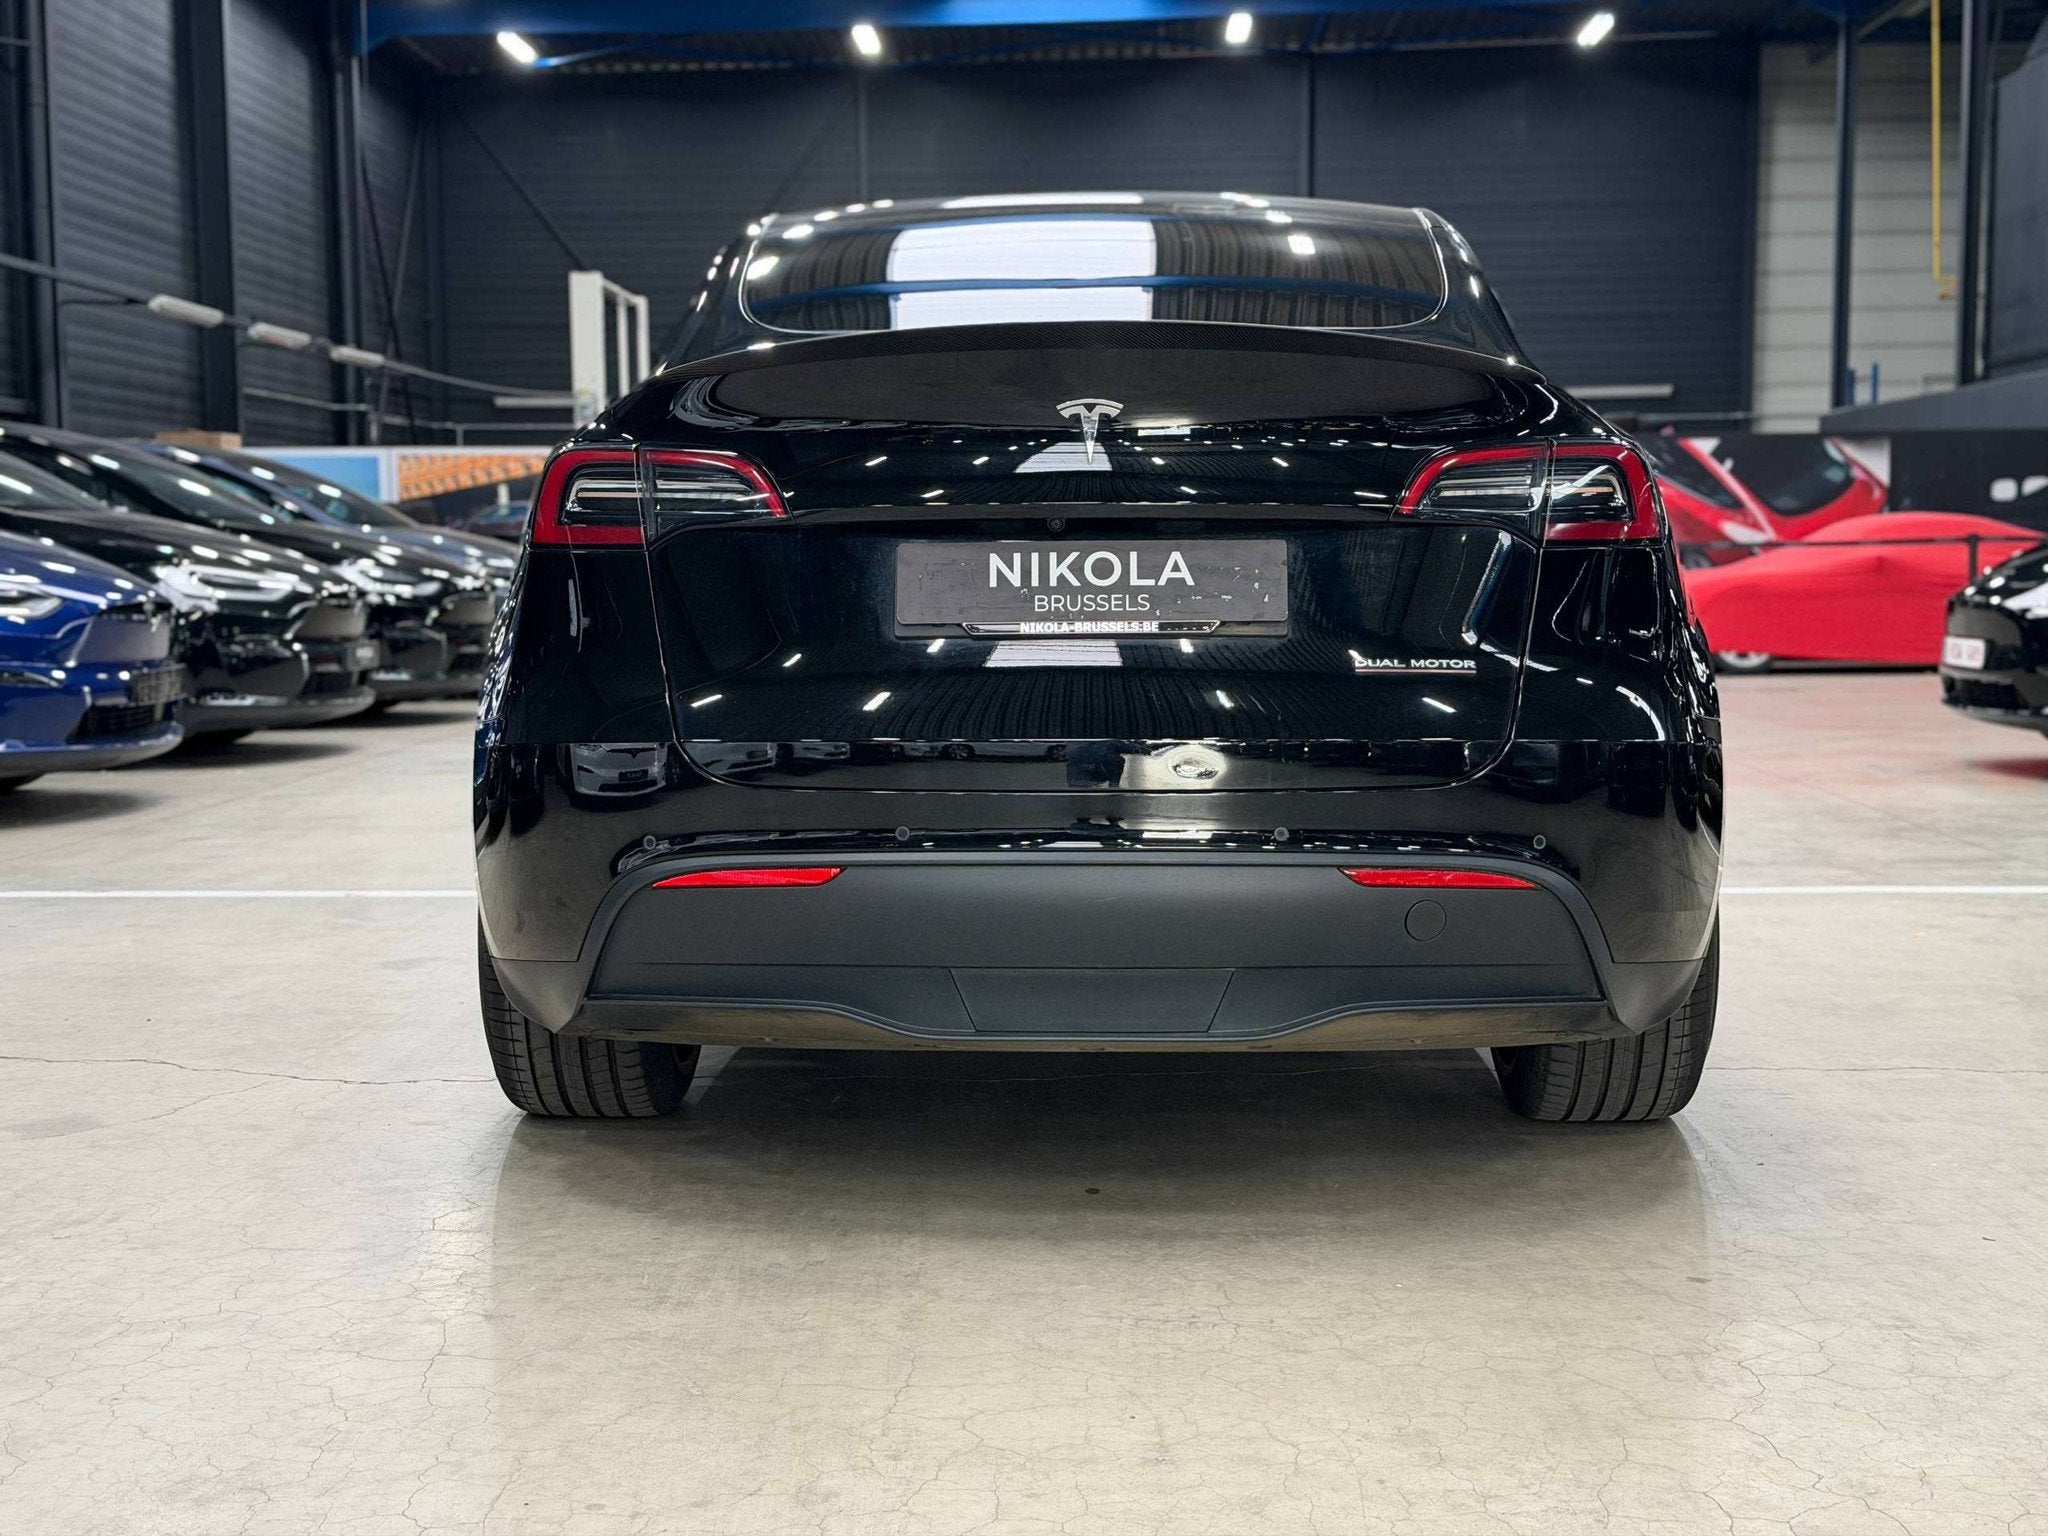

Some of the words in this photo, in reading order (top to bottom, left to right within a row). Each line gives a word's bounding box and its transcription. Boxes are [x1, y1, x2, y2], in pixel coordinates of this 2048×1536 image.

[988, 550, 1195, 588] NIKOLA
[1033, 594, 1151, 613] BRUSSELS
[1019, 621, 1160, 634] NIKOLA-BRUSSELS.BE
[1354, 658, 1406, 668] DUAL
[1410, 658, 1477, 669] MOTOR
